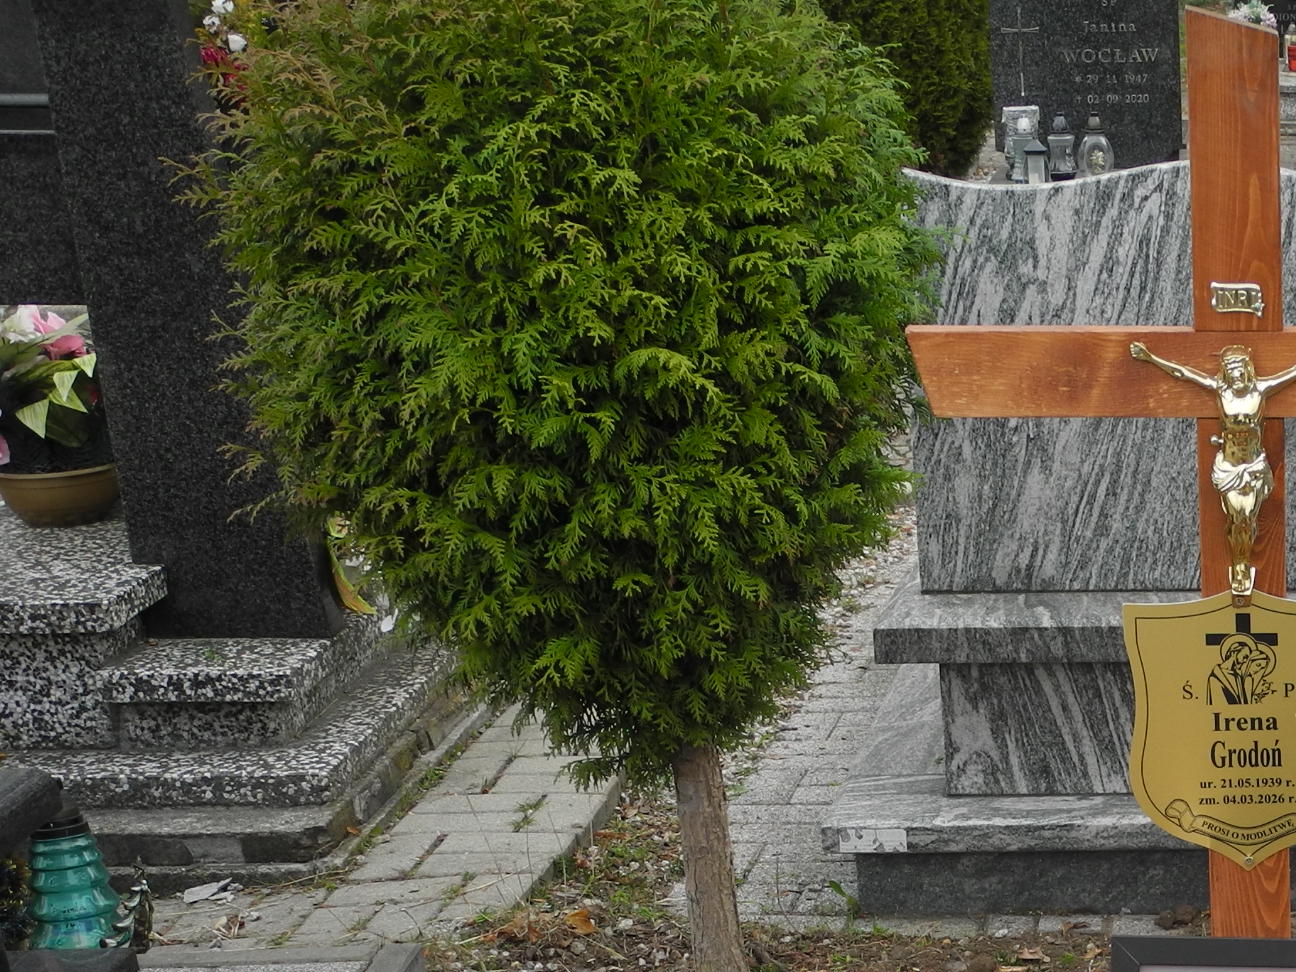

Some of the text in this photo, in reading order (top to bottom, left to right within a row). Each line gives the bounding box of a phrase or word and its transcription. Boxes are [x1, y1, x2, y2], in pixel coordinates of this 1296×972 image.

[1083, 20, 1137, 34] Janina
[1217, 290, 1257, 307] INRI
[1182, 680, 1199, 700] Ś.
[1212, 712, 1278, 732] Irena
[1210, 739, 1283, 769] Grodoń
[1200, 778, 1296, 789] ur. 21.05.1939 r.
[1199, 797, 1220, 805] zm.
[1223, 794, 1285, 804] 04.03.2026
[1202, 820, 1230, 837] PROSI
[1231, 831, 1240, 839] O
